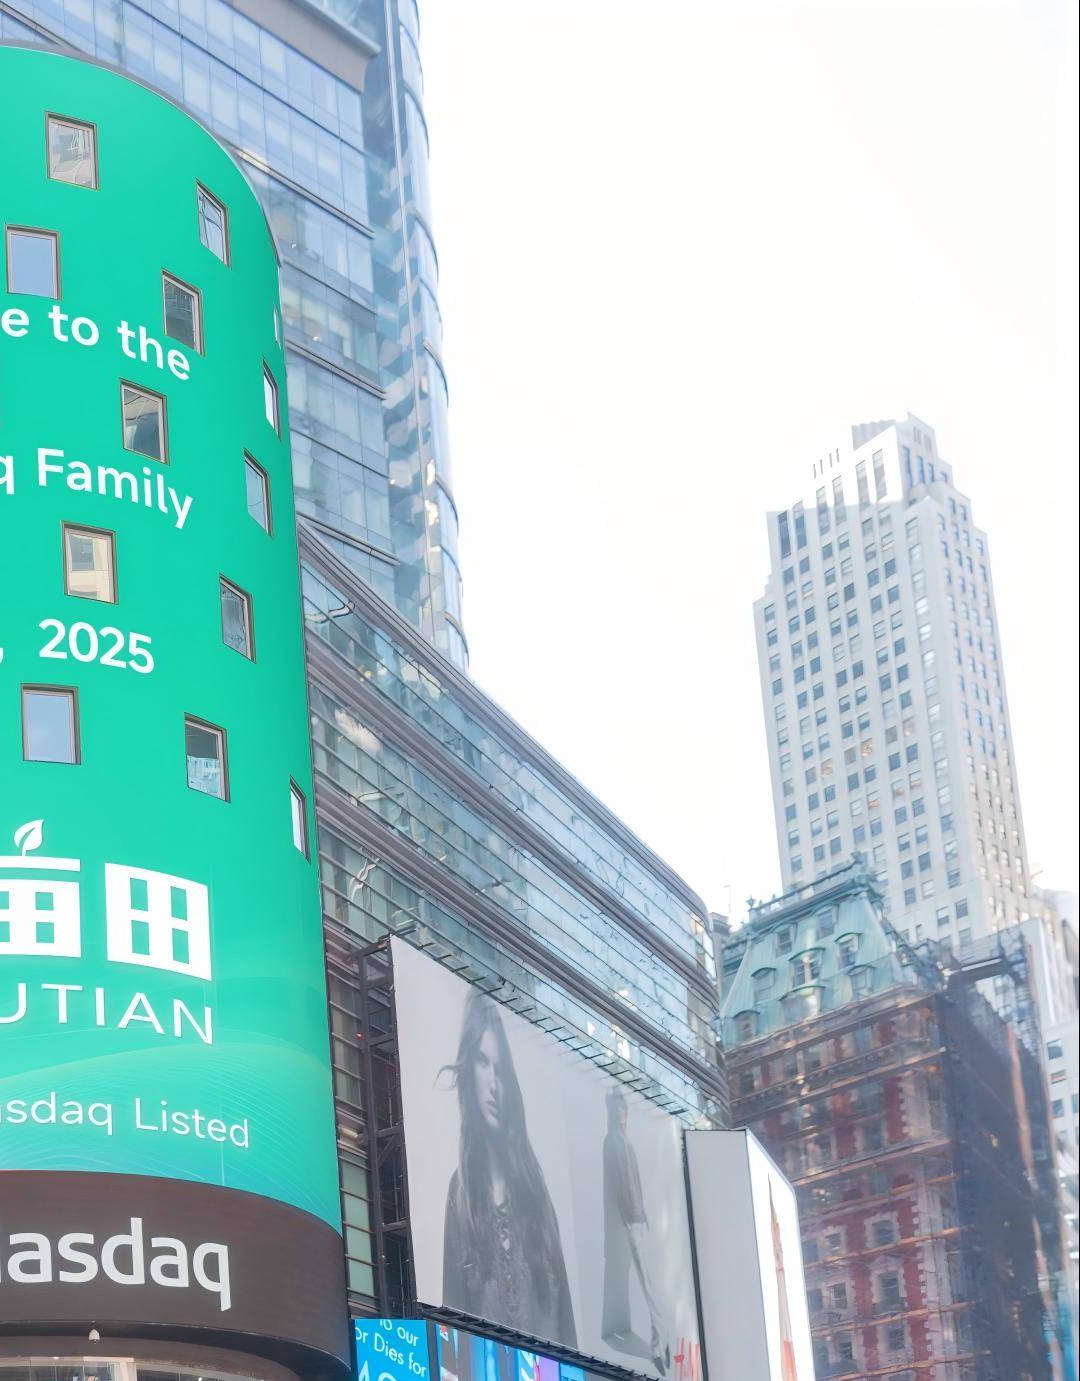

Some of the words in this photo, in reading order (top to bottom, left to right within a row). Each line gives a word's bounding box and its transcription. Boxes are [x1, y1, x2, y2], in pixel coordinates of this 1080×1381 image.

[47, 304, 100, 346] to
[116, 319, 192, 381] the
[36, 447, 194, 530] Family
[37, 618, 155, 674] 2025
[134, 1097, 251, 1149] Listed
[374, 1332, 405, 1366] Dies
[408, 1351, 427, 1377] for
[397, 1326, 419, 1347] our
